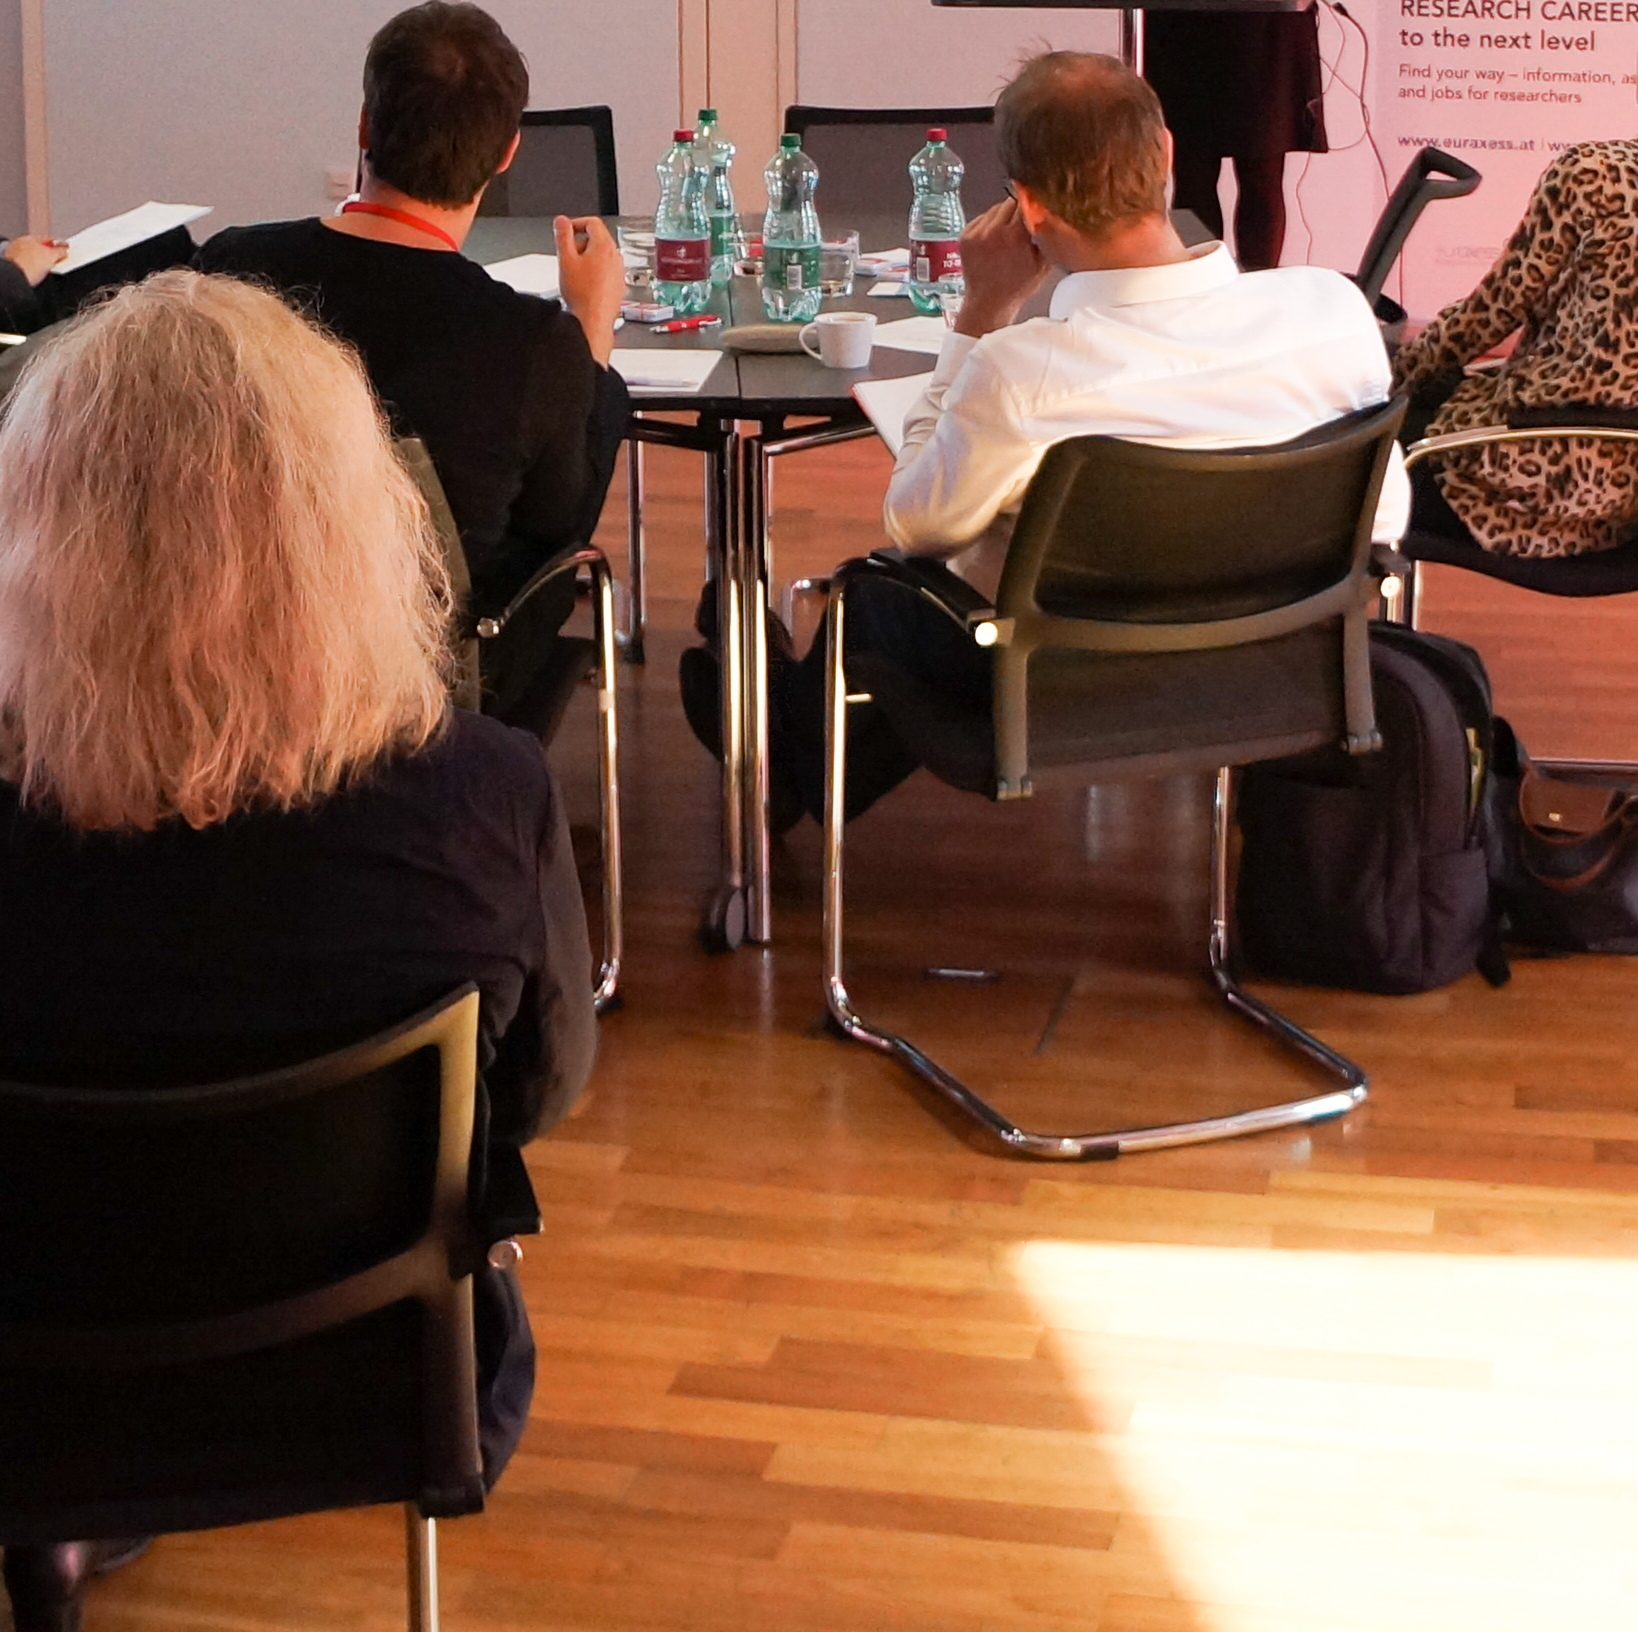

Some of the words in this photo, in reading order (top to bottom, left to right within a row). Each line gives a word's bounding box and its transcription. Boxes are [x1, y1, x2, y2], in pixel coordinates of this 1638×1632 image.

[1399, 28, 1424, 47] to
[1431, 26, 1470, 48] the
[1480, 31, 1532, 50] next
[1541, 29, 1595, 51] level
[1399, 64, 1431, 79] Find
[1436, 67, 1470, 82] your
[1475, 70, 1505, 84] way
[1523, 67, 1616, 85] information,
[1398, 85, 1426, 99] and
[1430, 86, 1462, 102] jobs
[1468, 86, 1489, 100] for
[1494, 89, 1582, 103] researchers
[1398, 135, 1535, 151] www.euraxess.at
